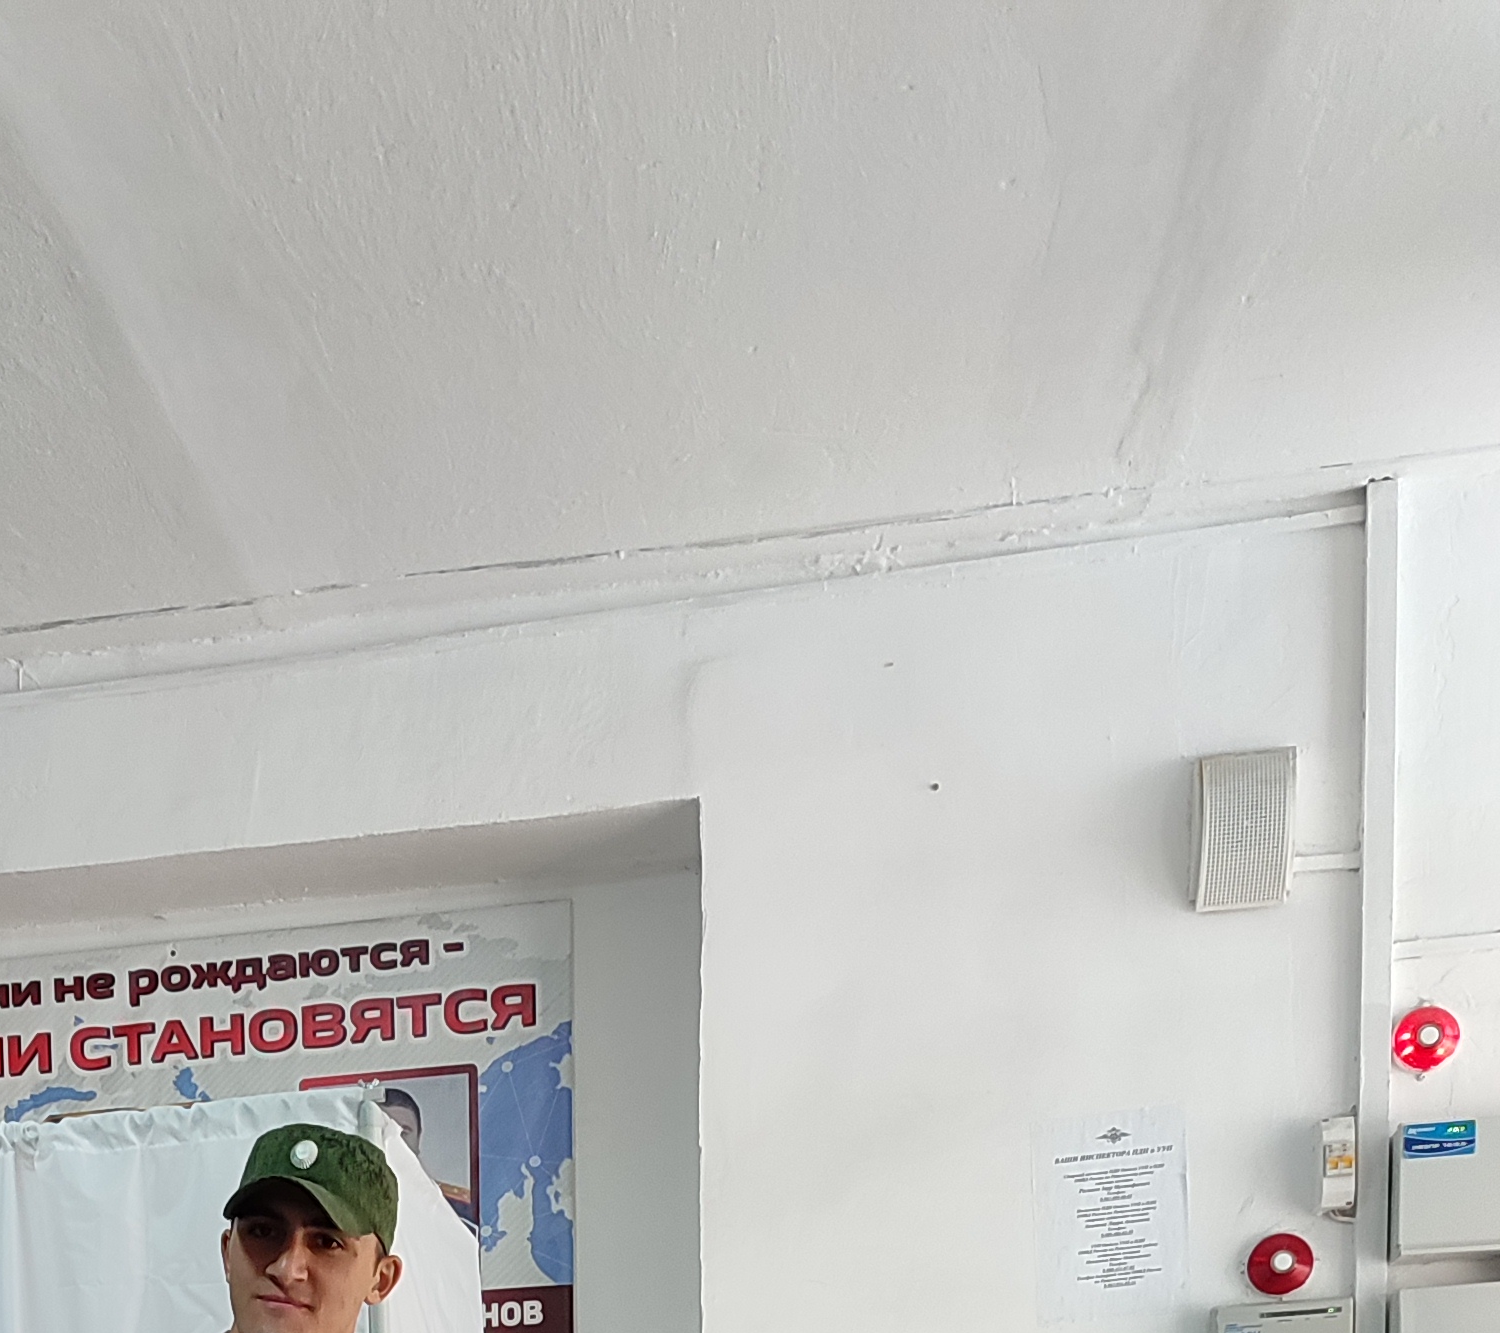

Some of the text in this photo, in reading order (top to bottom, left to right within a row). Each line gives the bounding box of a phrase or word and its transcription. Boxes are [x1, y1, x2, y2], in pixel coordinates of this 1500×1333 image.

[54, 972, 115, 1001] не
[128, 940, 430, 1006] рождаются
[70, 984, 536, 1071] СТАНОВЯТСЯ
[482, 1300, 544, 1327] НОВ
